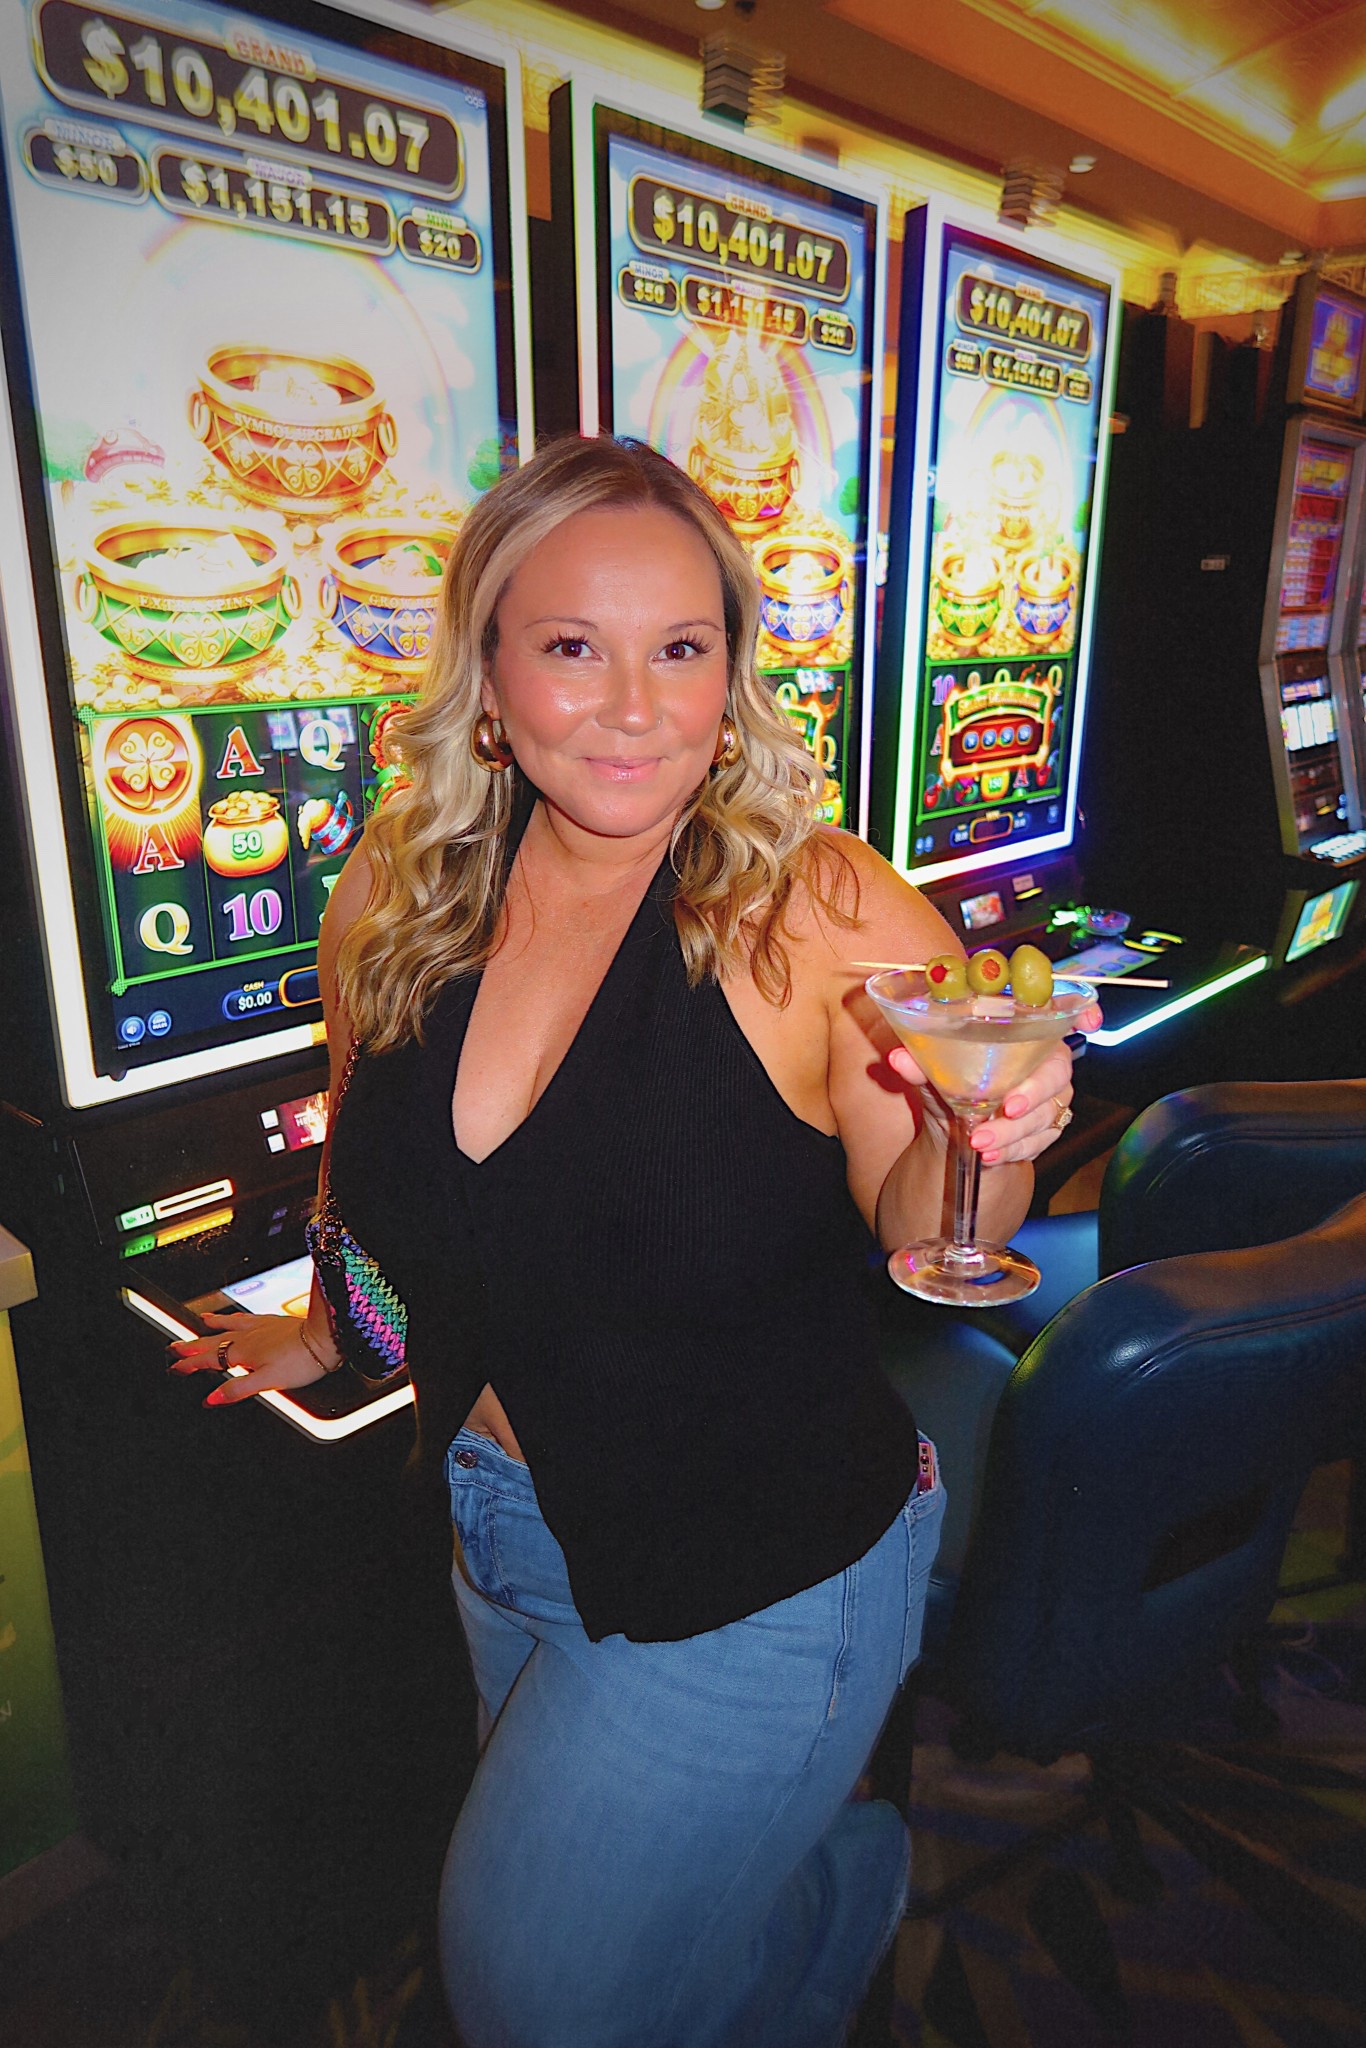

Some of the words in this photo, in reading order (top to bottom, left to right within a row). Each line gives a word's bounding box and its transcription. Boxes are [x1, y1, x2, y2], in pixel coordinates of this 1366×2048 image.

[232, 32, 305, 76] GRAND
[81, 18, 431, 175] $10,401.07
[54, 124, 115, 152] MINOR
[52, 141, 118, 187] $50
[254, 162, 306, 187] MAJOR
[179, 160, 371, 240] $1,151.15
[730, 195, 768, 218] GRAND
[418, 227, 461, 261] $20
[653, 187, 834, 284] $10,401.07
[633, 277, 666, 305] $50
[634, 264, 664, 281] MINOR
[820, 322, 846, 346] $20
[970, 281, 1083, 350] $10,401.07
[216, 725, 265, 779] A
[299, 719, 346, 771] Q
[132, 824, 185, 875] A
[232, 830, 264, 859] 50
[139, 902, 194, 955] Q
[222, 889, 283, 941] 10
[238, 991, 273, 1011] $0.00
[243, 981, 264, 992] CASH
